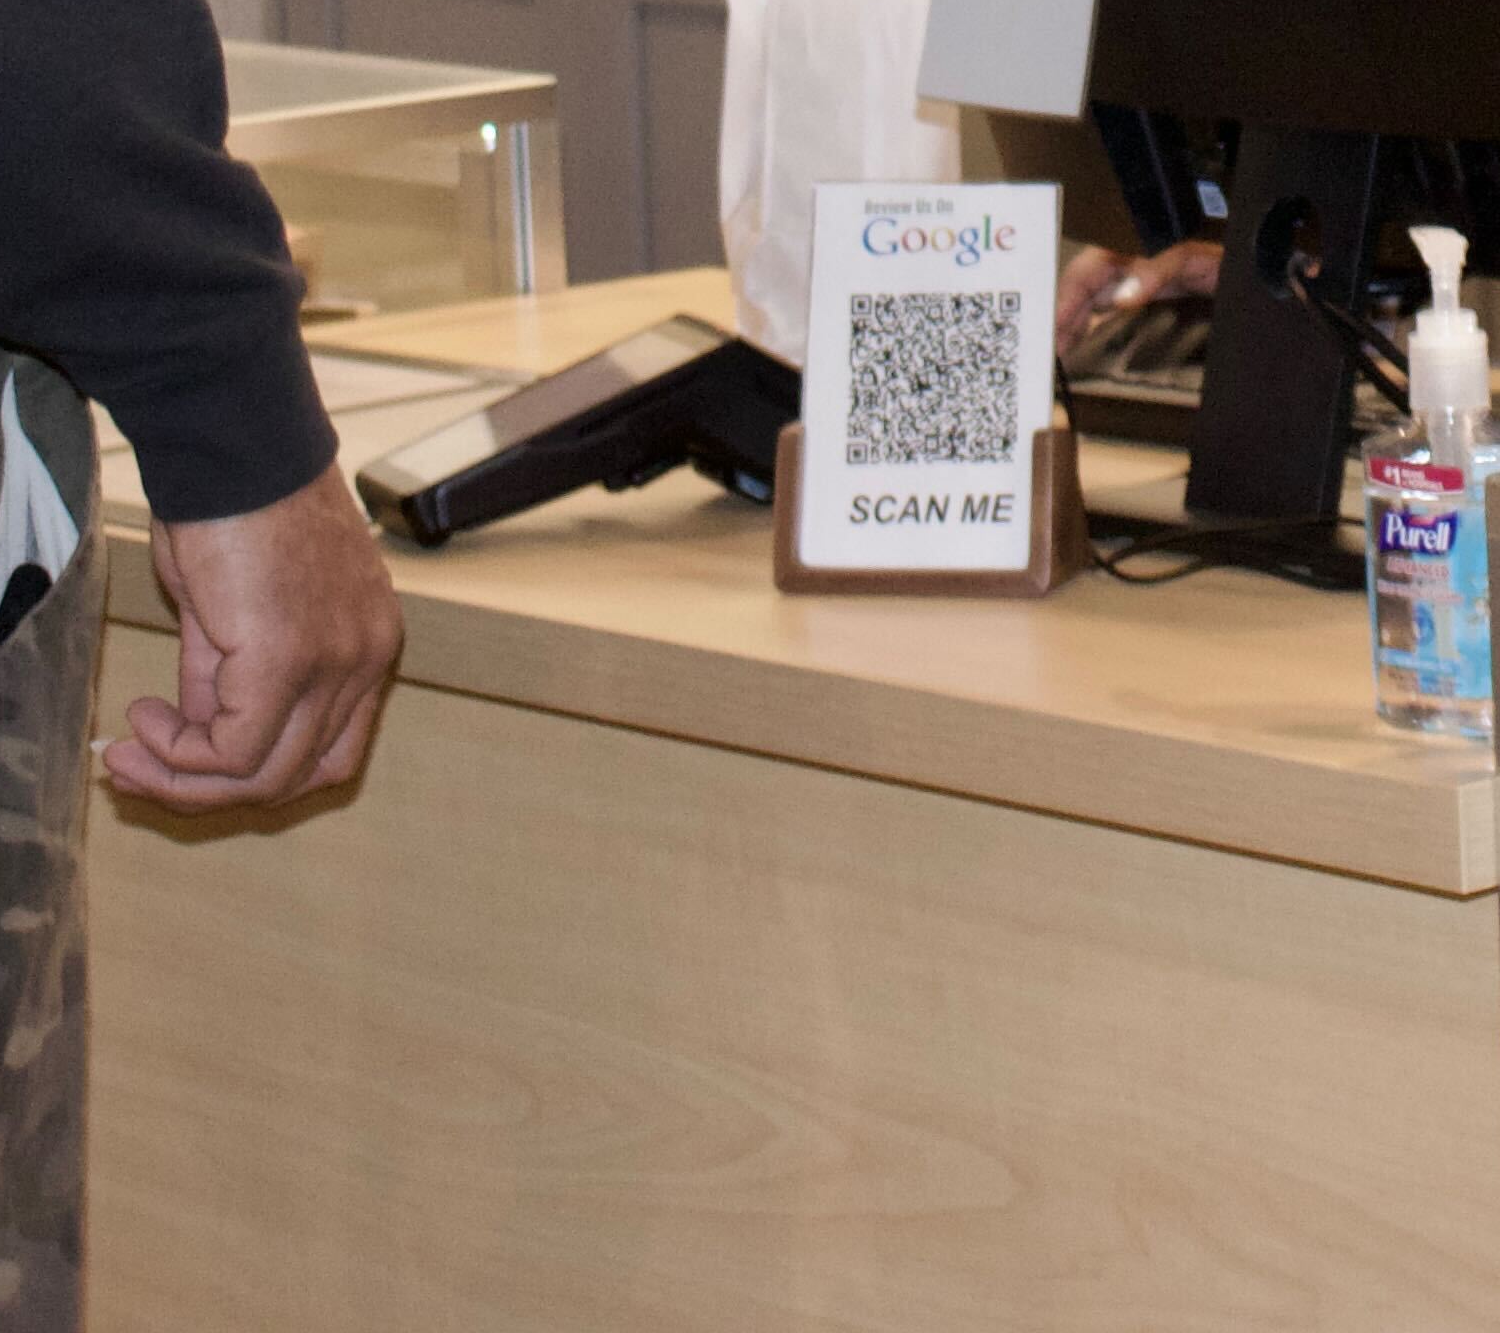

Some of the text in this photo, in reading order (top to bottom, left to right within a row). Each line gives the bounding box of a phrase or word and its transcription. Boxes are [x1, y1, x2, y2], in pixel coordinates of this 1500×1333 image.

[861, 214, 1017, 268] Google
[849, 493, 1016, 524] SCAN ME
[1386, 511, 1450, 551] Purell
